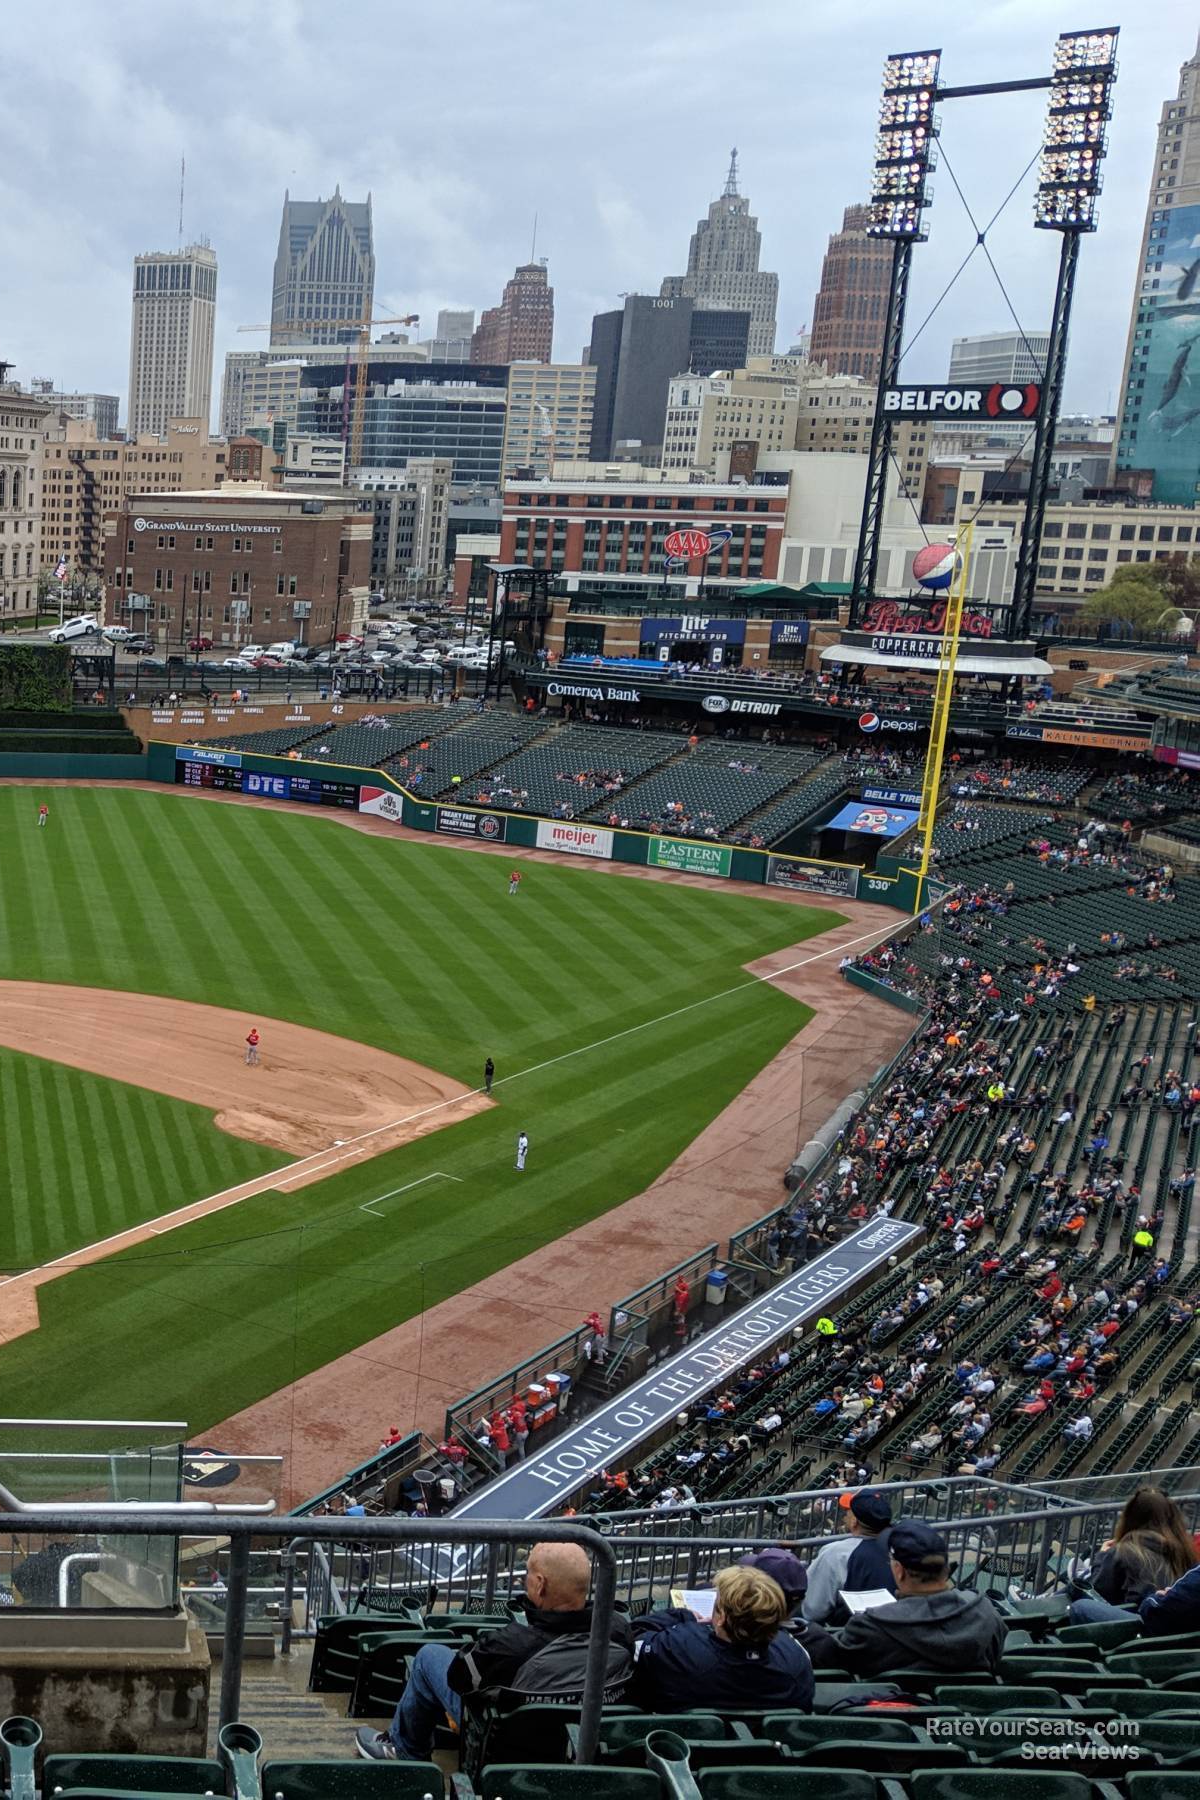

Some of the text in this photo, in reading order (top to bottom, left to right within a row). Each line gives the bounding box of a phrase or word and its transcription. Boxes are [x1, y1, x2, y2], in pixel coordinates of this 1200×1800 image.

[652, 300, 674, 308] 1001
[884, 391, 982, 410] BELFOR
[146, 521, 281, 533] GRAND VALLEY STATE UNIVERSITY
[863, 600, 923, 633] PEPSI
[681, 615, 710, 633] Lite
[783, 625, 799, 634] Lite
[659, 633, 706, 641] PITCHER'S
[607, 688, 640, 701] Bank
[294, 706, 303, 714] 11
[332, 705, 343, 714] 42
[708, 698, 782, 715] FOX DETROIT
[881, 720, 917, 732] pepsi
[1102, 738, 1146, 748] CORNER
[248, 774, 285, 794] DTE
[864, 790, 922, 803] BELLE TIRE
[380, 804, 399, 817] VISION
[441, 810, 462, 819] FREAKY
[553, 827, 597, 845] meijer
[659, 840, 722, 861] EASTERN
[868, 880, 890, 891] 330'
[528, 1263, 850, 1487] HOME OF THE DETROIT TIGERS
